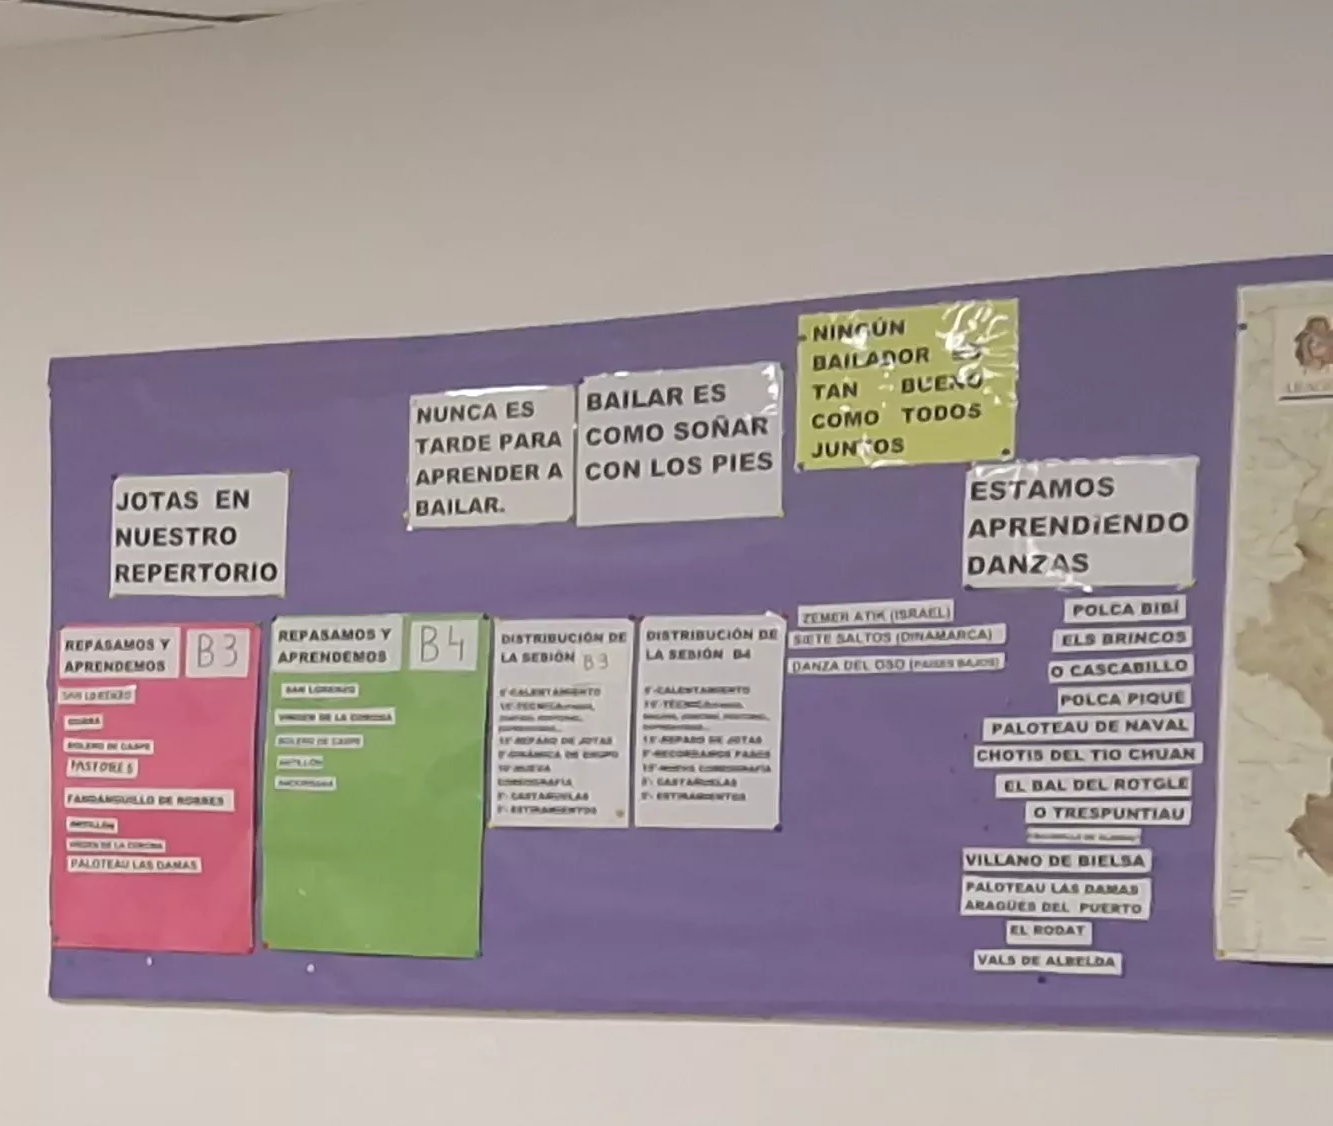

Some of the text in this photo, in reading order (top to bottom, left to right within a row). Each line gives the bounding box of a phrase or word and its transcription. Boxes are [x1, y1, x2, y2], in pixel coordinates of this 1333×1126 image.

[813, 347, 930, 372] BAILADOR
[586, 384, 727, 411] BAILAR ES
[813, 382, 858, 400] TAN
[416, 401, 535, 425] NUNCA ES
[812, 403, 982, 430] COMO TODOS
[586, 411, 769, 446] COMO SOÑAR
[415, 431, 563, 455] TARDE PARA
[812, 438, 905, 459] JUNOS
[415, 462, 564, 486] APRENDER A
[585, 451, 774, 481] CON LOS PIES
[970, 476, 1116, 502] ESTAMOS
[116, 489, 250, 511] JOTAS EN
[415, 497, 506, 517] BAILAR.
[115, 527, 237, 548] NUESTRO
[115, 562, 278, 583] REPERTORIO
[967, 551, 1090, 577] DANZAS
[890, 607, 951, 623] (ISRAEL)
[1072, 602, 1135, 617] POLCA
[278, 628, 393, 642] REPASAMOS Y
[501, 631, 627, 645] DISTRIBUCIÓN DE
[646, 628, 779, 641] DISTRIBUCIÓN DE
[794, 629, 992, 646] SIETE SALTOS (DINAMARCA)
[1062, 630, 1187, 646] ELS BRINCOS
[65, 638, 171, 652] REPASAMOS Y
[196, 633, 239, 669] B3
[420, 625, 465, 663] B4
[278, 650, 387, 664] APRENDEMOS
[500, 650, 576, 664] LA SESIÓN
[646, 649, 665, 661] LA
[668, 647, 724, 661] SESIÓN
[64, 660, 166, 673] APRENDEMOS
[792, 660, 840, 672] DANZA
[844, 660, 870, 671] DEL
[874, 659, 906, 671] OSO
[1051, 659, 1188, 678] O CASCABILLO
[1061, 693, 1121, 706] POLCA
[991, 718, 1189, 735] PALOTEAU DE NAVAL
[976, 748, 1044, 762] CHOTIS
[1050, 749, 1085, 762] DEL
[1128, 747, 1195, 761] CHUAN
[1004, 776, 1189, 794] EL BAL DEL ROTGLE
[1034, 805, 1185, 821] O TRESPUNTIAU
[132, 859, 154, 870] LAS
[966, 854, 1146, 868] VILLANO DE BIELSA
[966, 881, 1139, 896] PALOTEAU LAS DAMAS
[1041, 900, 1070, 913] DEL
[1079, 902, 1143, 914] PUERTO
[1009, 924, 1086, 937] EL RODAT
[977, 954, 1116, 967] VALS DE ALBELDA
